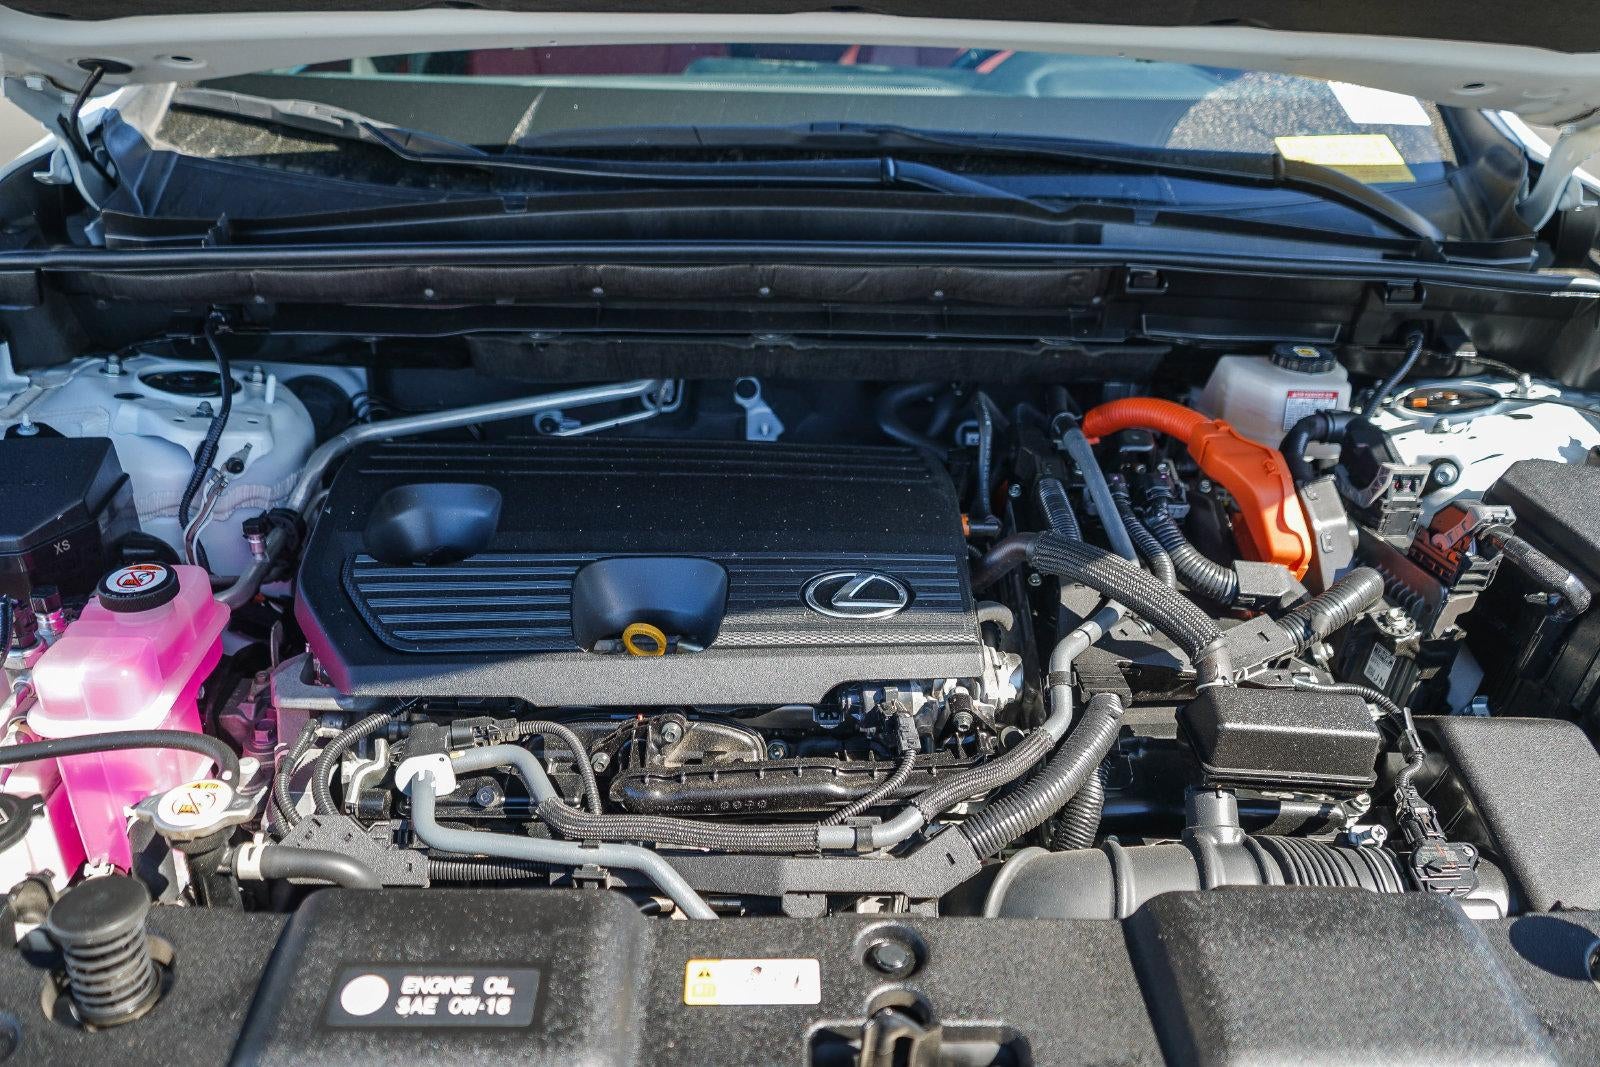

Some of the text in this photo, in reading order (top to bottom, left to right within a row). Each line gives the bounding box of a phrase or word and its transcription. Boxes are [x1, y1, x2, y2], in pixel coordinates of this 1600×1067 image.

[53, 539, 71, 555] XS
[400, 975, 515, 995] ENGINE OIL
[395, 995, 512, 1016] SAE 0W-16
